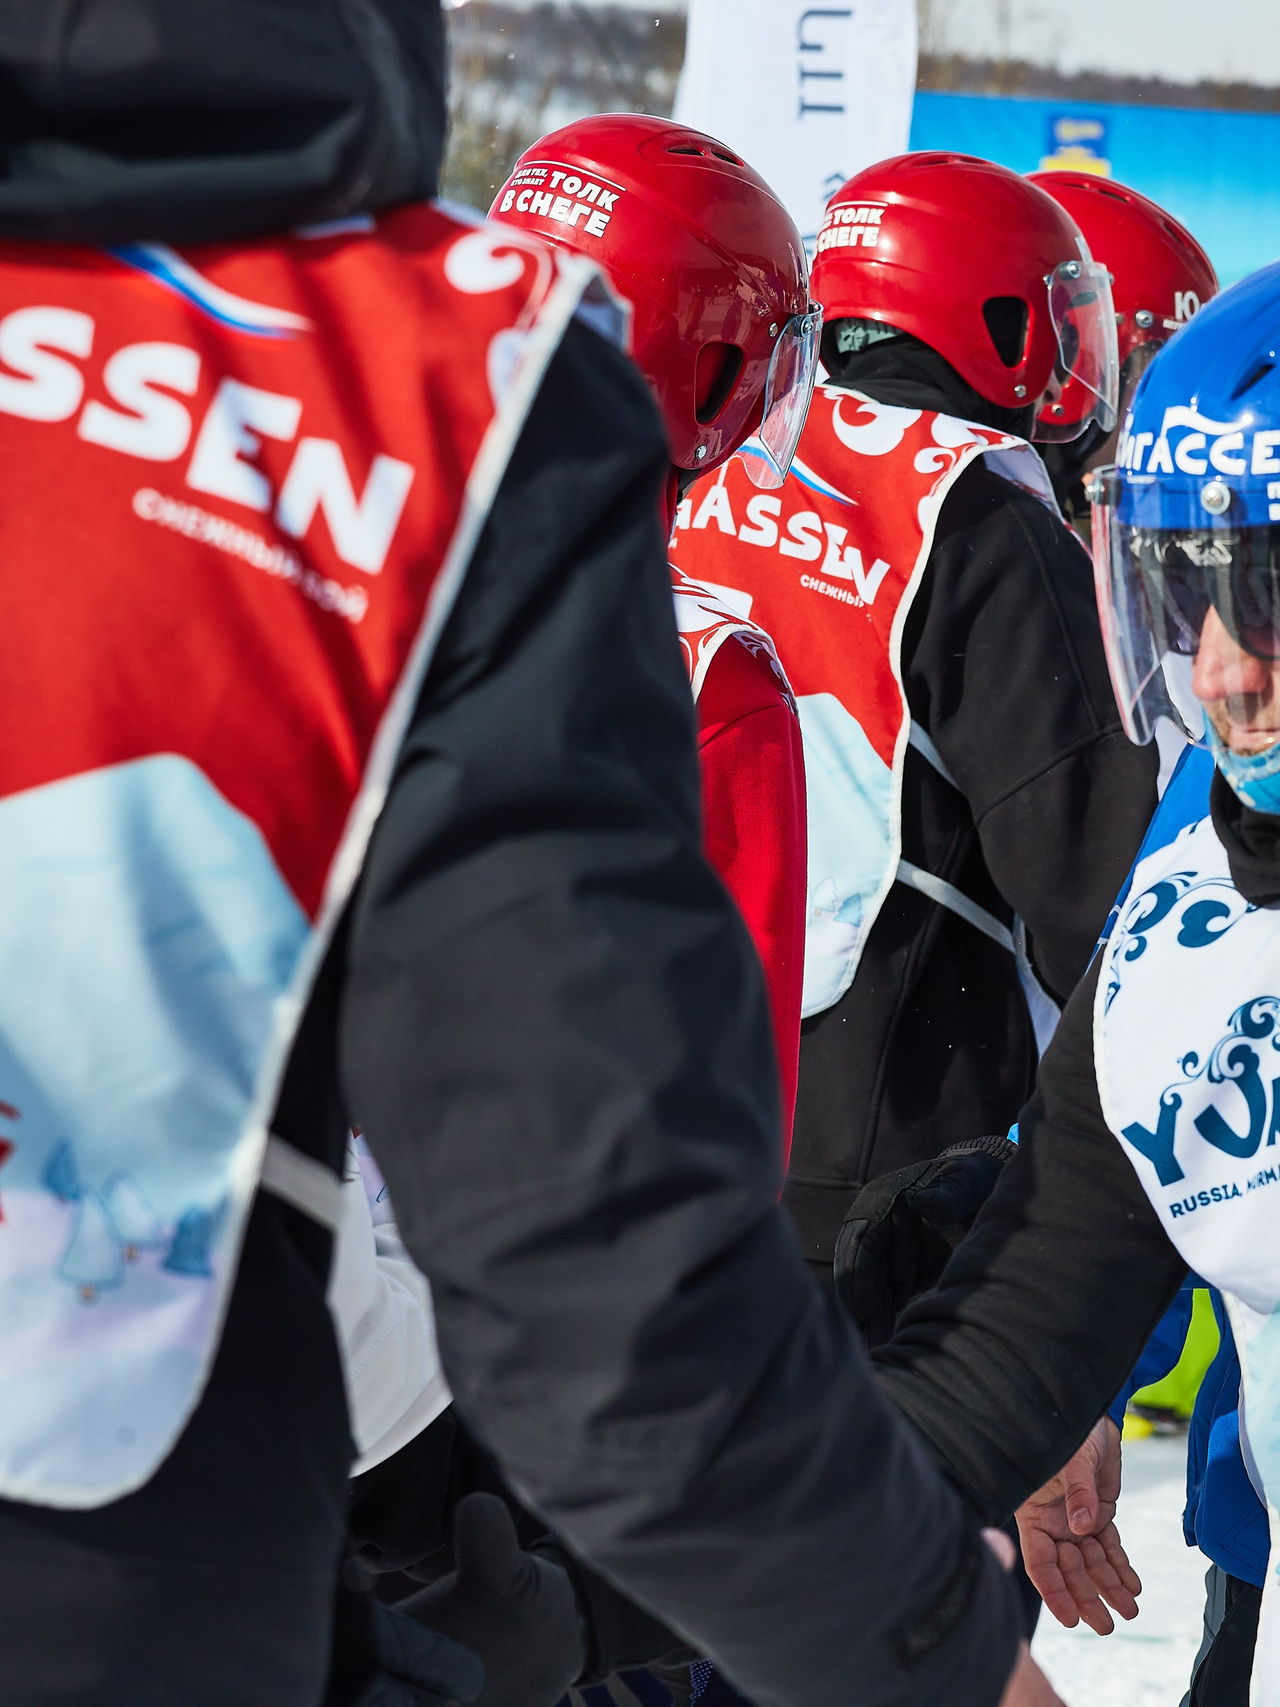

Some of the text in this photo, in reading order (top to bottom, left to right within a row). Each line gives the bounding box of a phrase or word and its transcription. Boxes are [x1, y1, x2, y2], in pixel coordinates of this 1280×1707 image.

[550, 171, 620, 212] ТОЛК
[499, 189, 611, 238] В СНЕГЕ
[833, 207, 885, 225] ТОЛК
[1169, 1182, 1243, 1218] RUSSIA,
